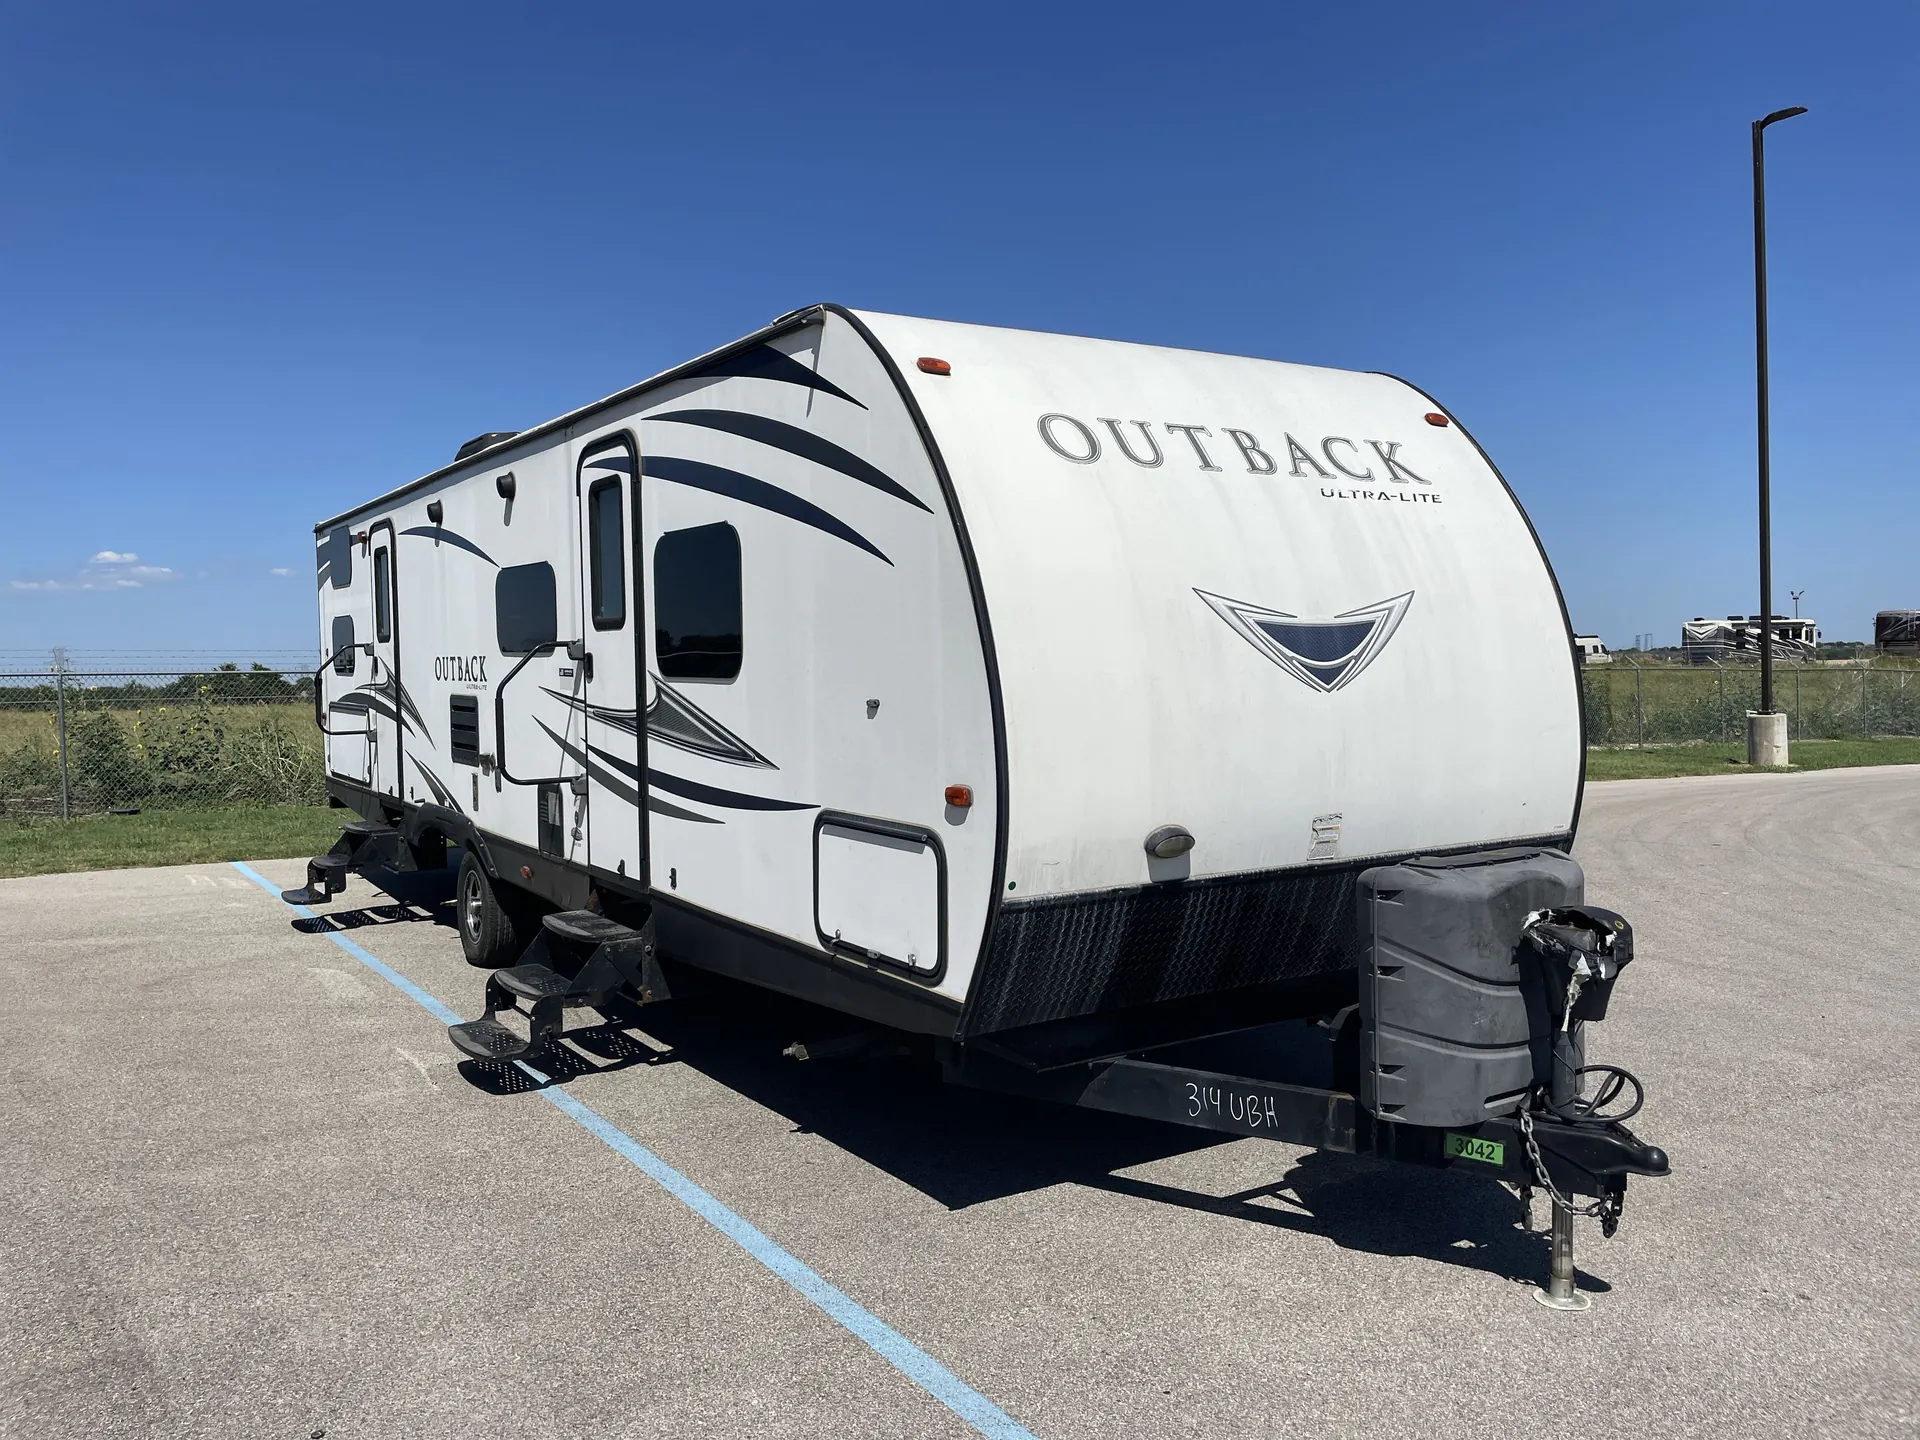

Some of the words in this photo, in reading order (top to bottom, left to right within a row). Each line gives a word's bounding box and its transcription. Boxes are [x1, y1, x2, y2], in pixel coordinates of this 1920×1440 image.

[1037, 412, 1432, 485] OUTBACK
[1320, 488, 1442, 503] ULTRA-LITE
[434, 655, 488, 682] OUTBACK
[1186, 1082, 1221, 1117] 314
[1229, 1092, 1279, 1128] UBH
[1454, 1137, 1496, 1161] 3042
